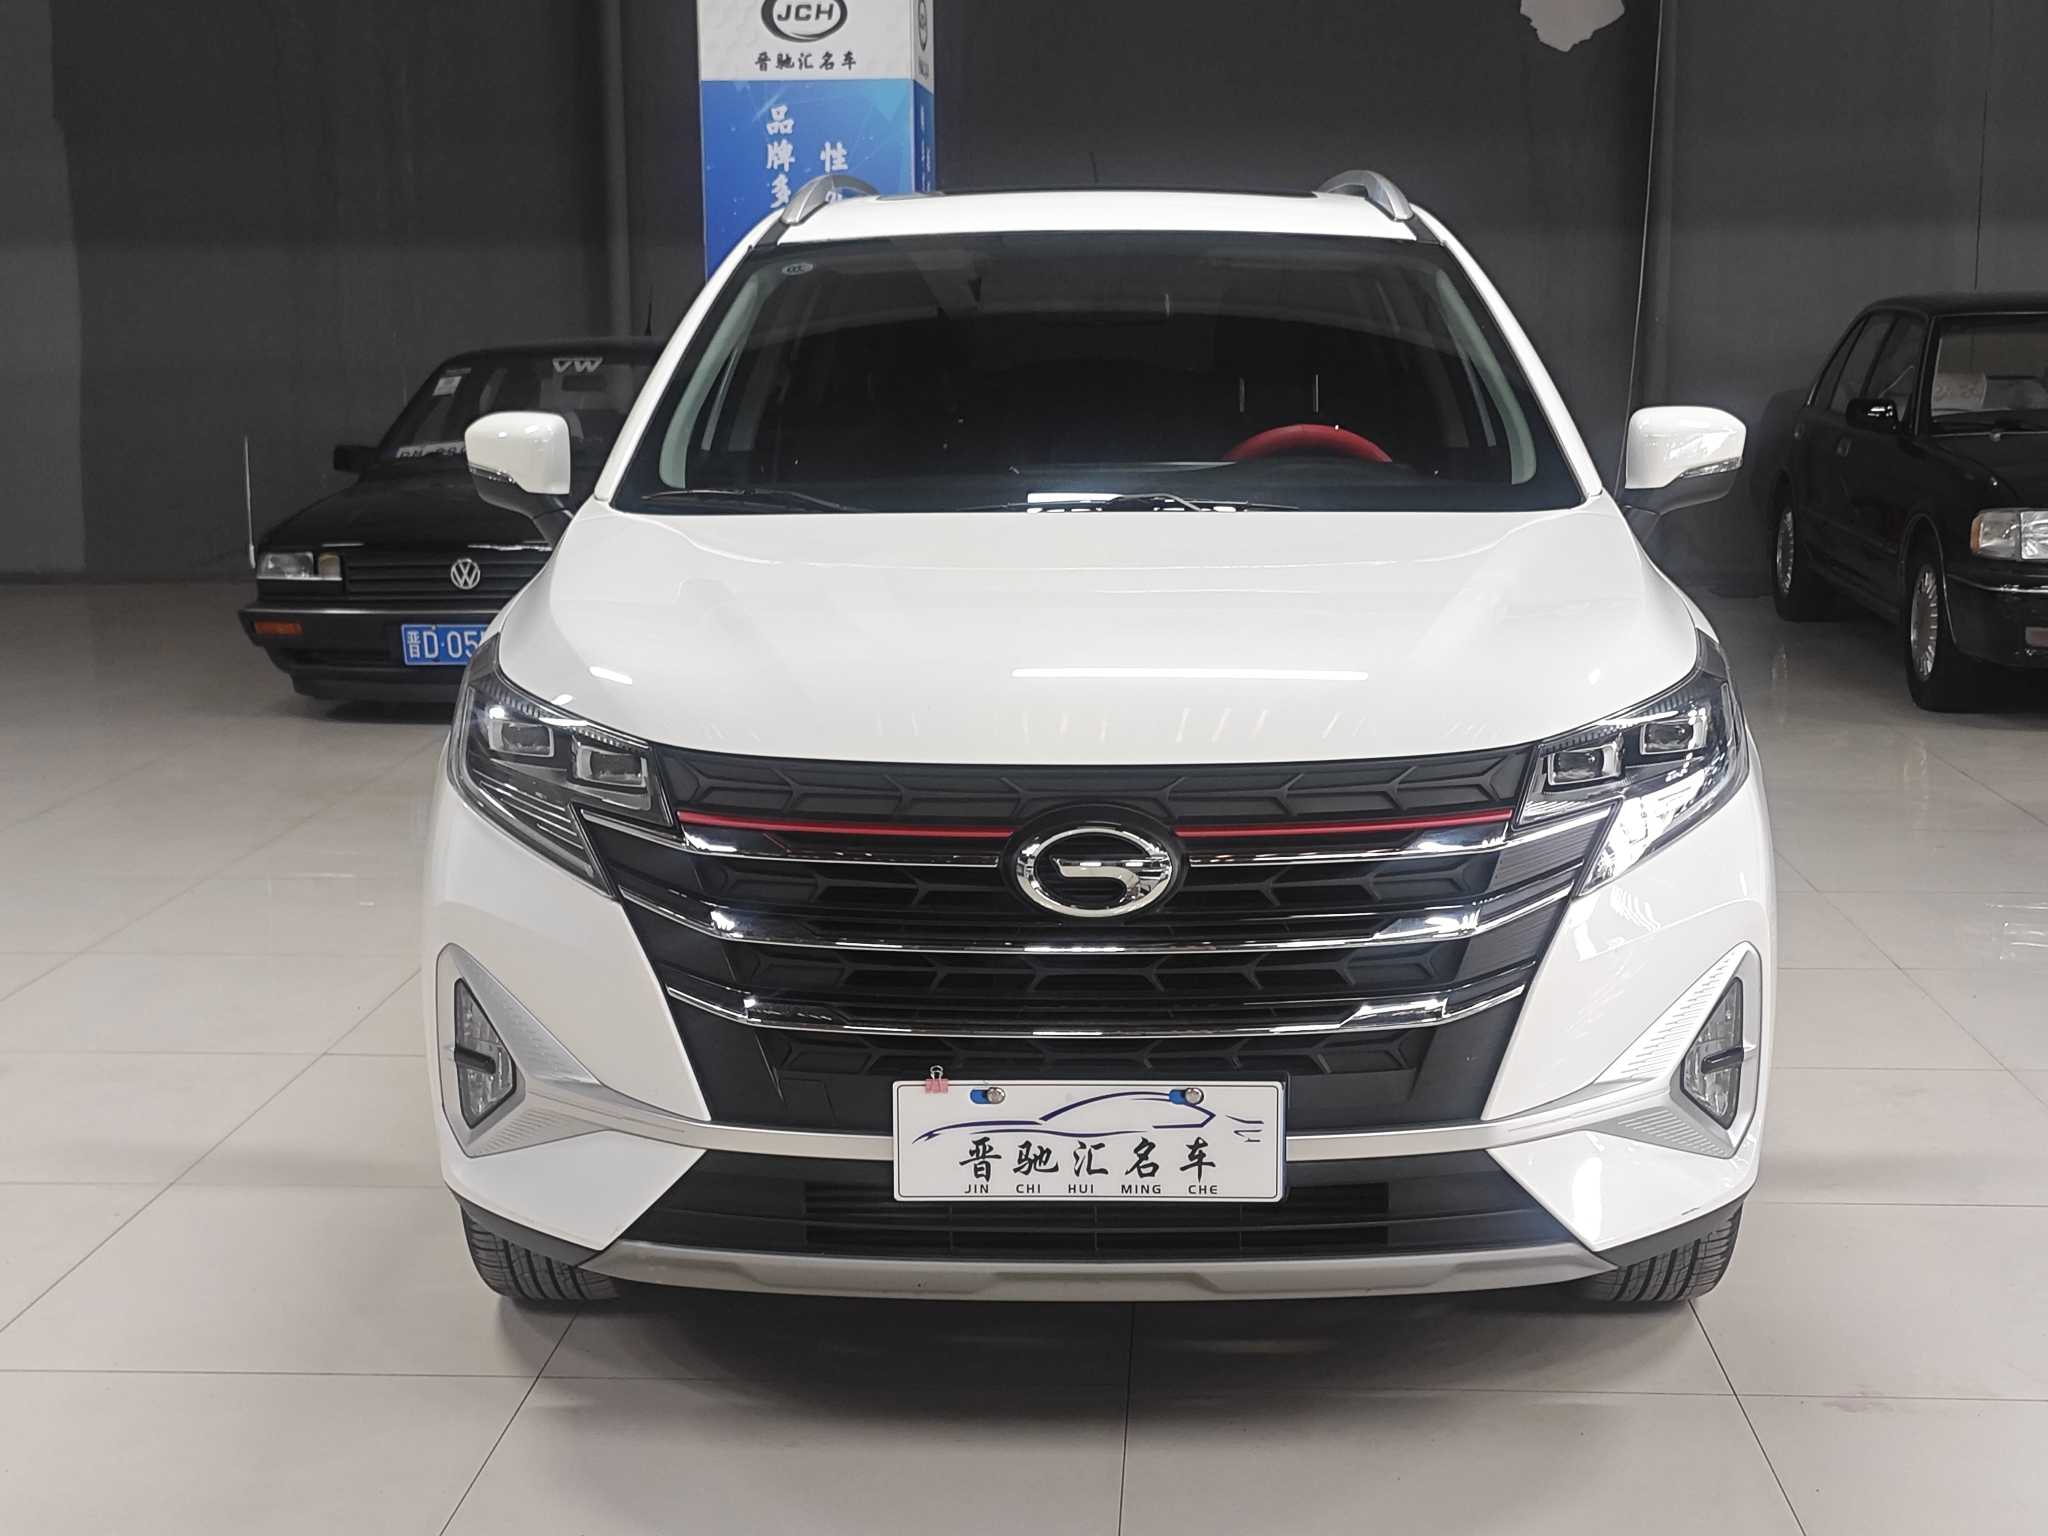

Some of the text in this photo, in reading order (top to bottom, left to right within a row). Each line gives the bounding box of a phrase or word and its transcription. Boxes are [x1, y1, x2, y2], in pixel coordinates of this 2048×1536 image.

[776, 3, 834, 21] JCH
[754, 50, 857, 72] 晋驰汇名车
[959, 1136, 1217, 1183] 晋驰汇名车
[964, 1184, 1218, 1195] JIN CHI HUI MING CHE
